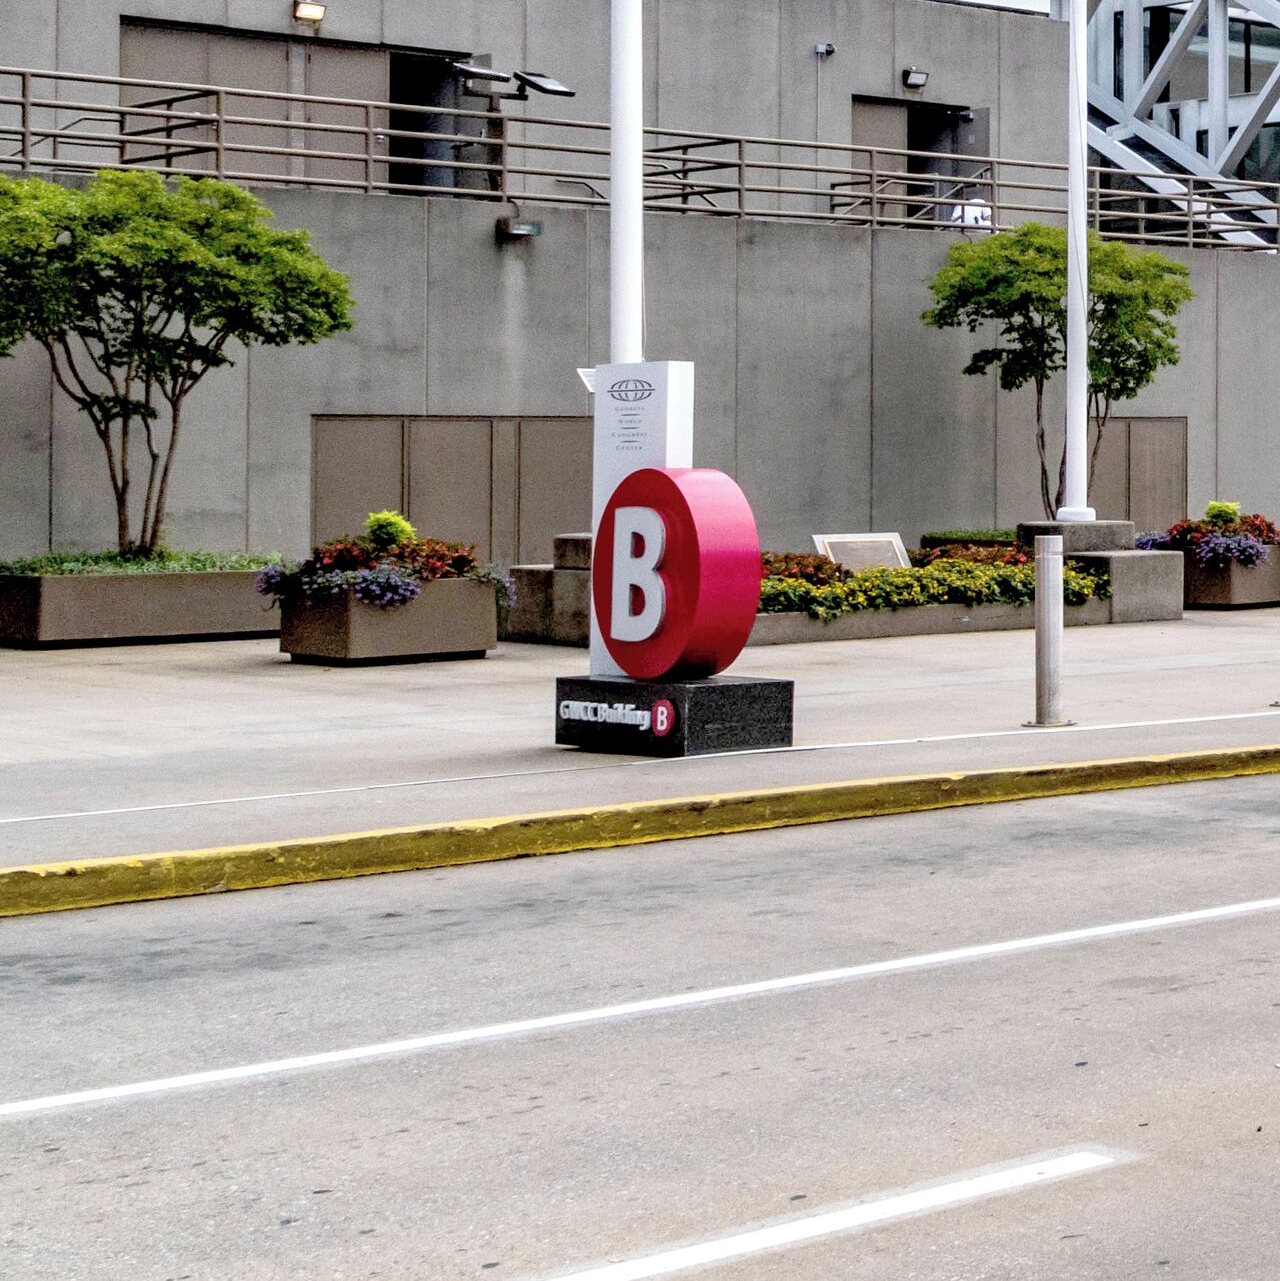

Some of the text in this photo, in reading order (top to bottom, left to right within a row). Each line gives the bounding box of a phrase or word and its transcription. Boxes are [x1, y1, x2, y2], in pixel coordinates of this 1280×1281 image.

[610, 506, 666, 642] B
[560, 700, 668, 731] GWCC Building B
